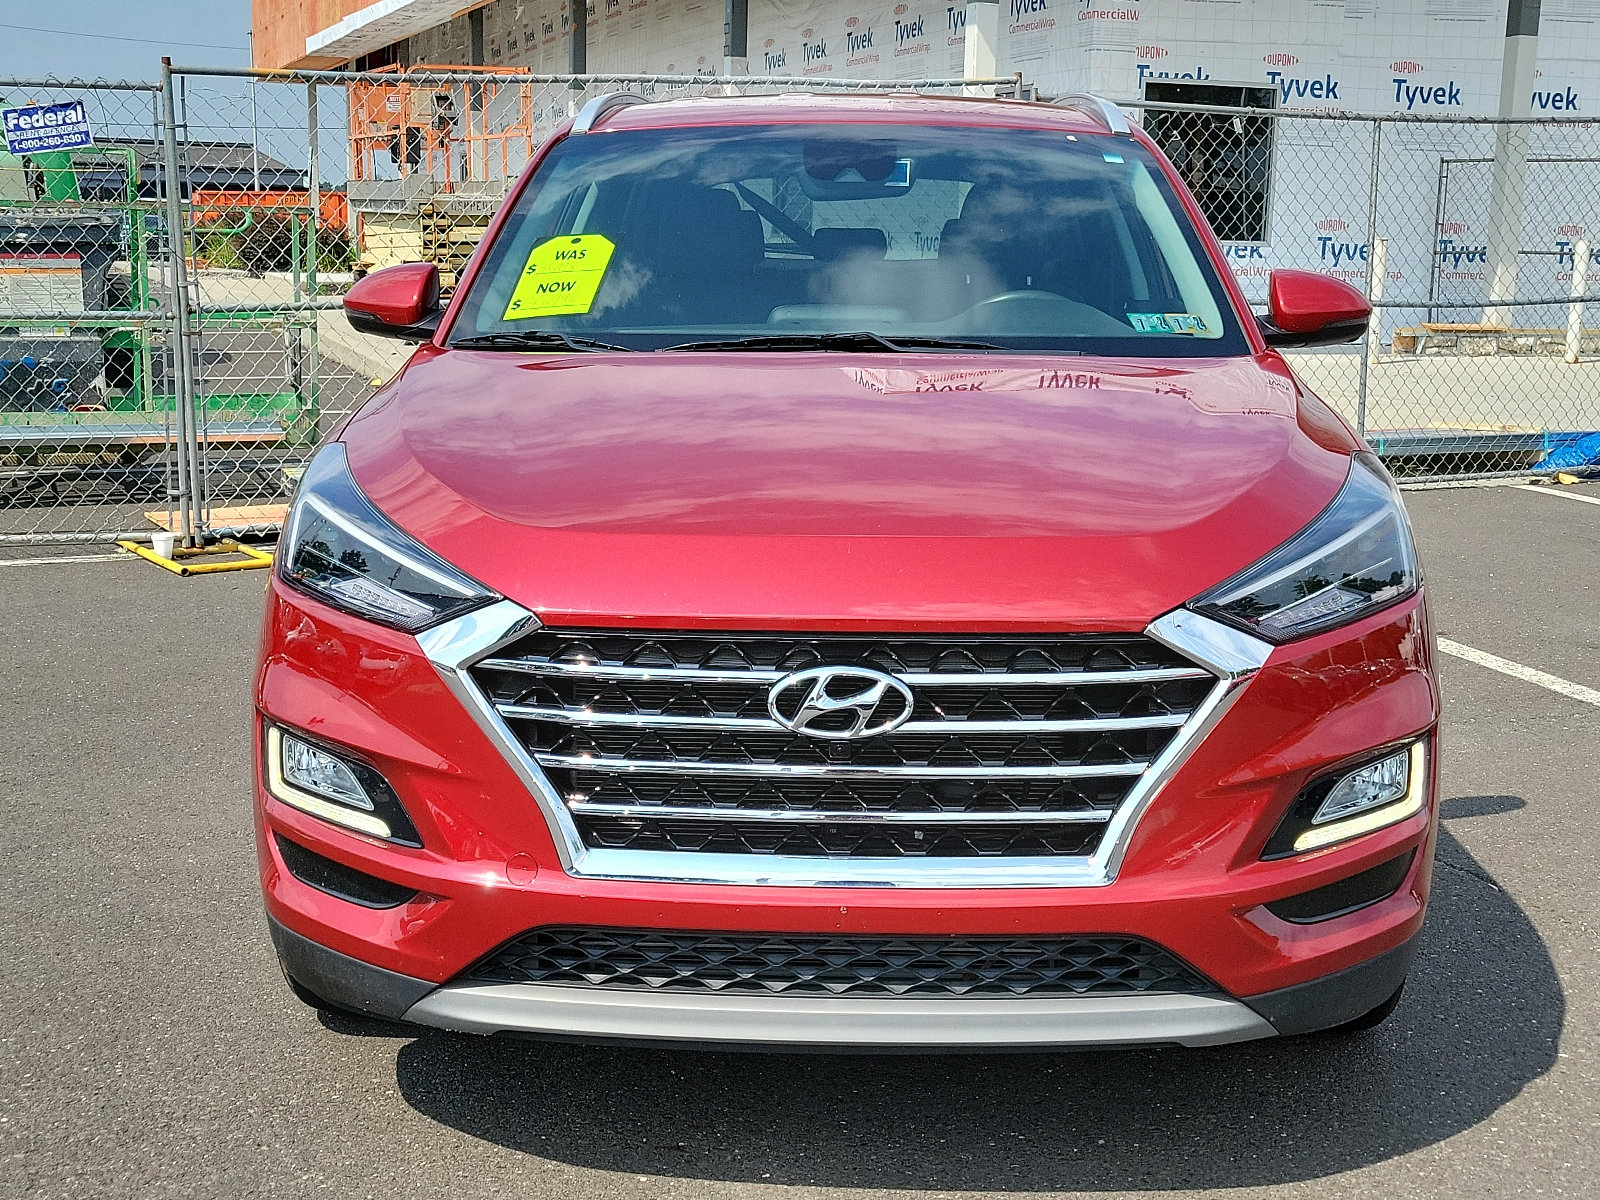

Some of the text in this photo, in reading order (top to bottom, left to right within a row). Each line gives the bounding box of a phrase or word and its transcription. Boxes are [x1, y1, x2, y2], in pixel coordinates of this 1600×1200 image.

[895, 15, 924, 47] Tyvek
[1009, 18, 1055, 34] CommercialWrap
[802, 38, 827, 66] Tyvek
[847, 27, 873, 57] Tyvek
[764, 48, 786, 75] Tyvek
[1265, 53, 1296, 67] DUPONT
[1392, 61, 1421, 74] DUPONT
[1267, 71, 1339, 104] Tyvek
[1393, 78, 1461, 110] Tyvek
[7, 105, 82, 129] Federal
[555, 249, 587, 261] WAS
[526, 264, 537, 275] $
[536, 281, 577, 294] NOW
[511, 299, 521, 310] $
